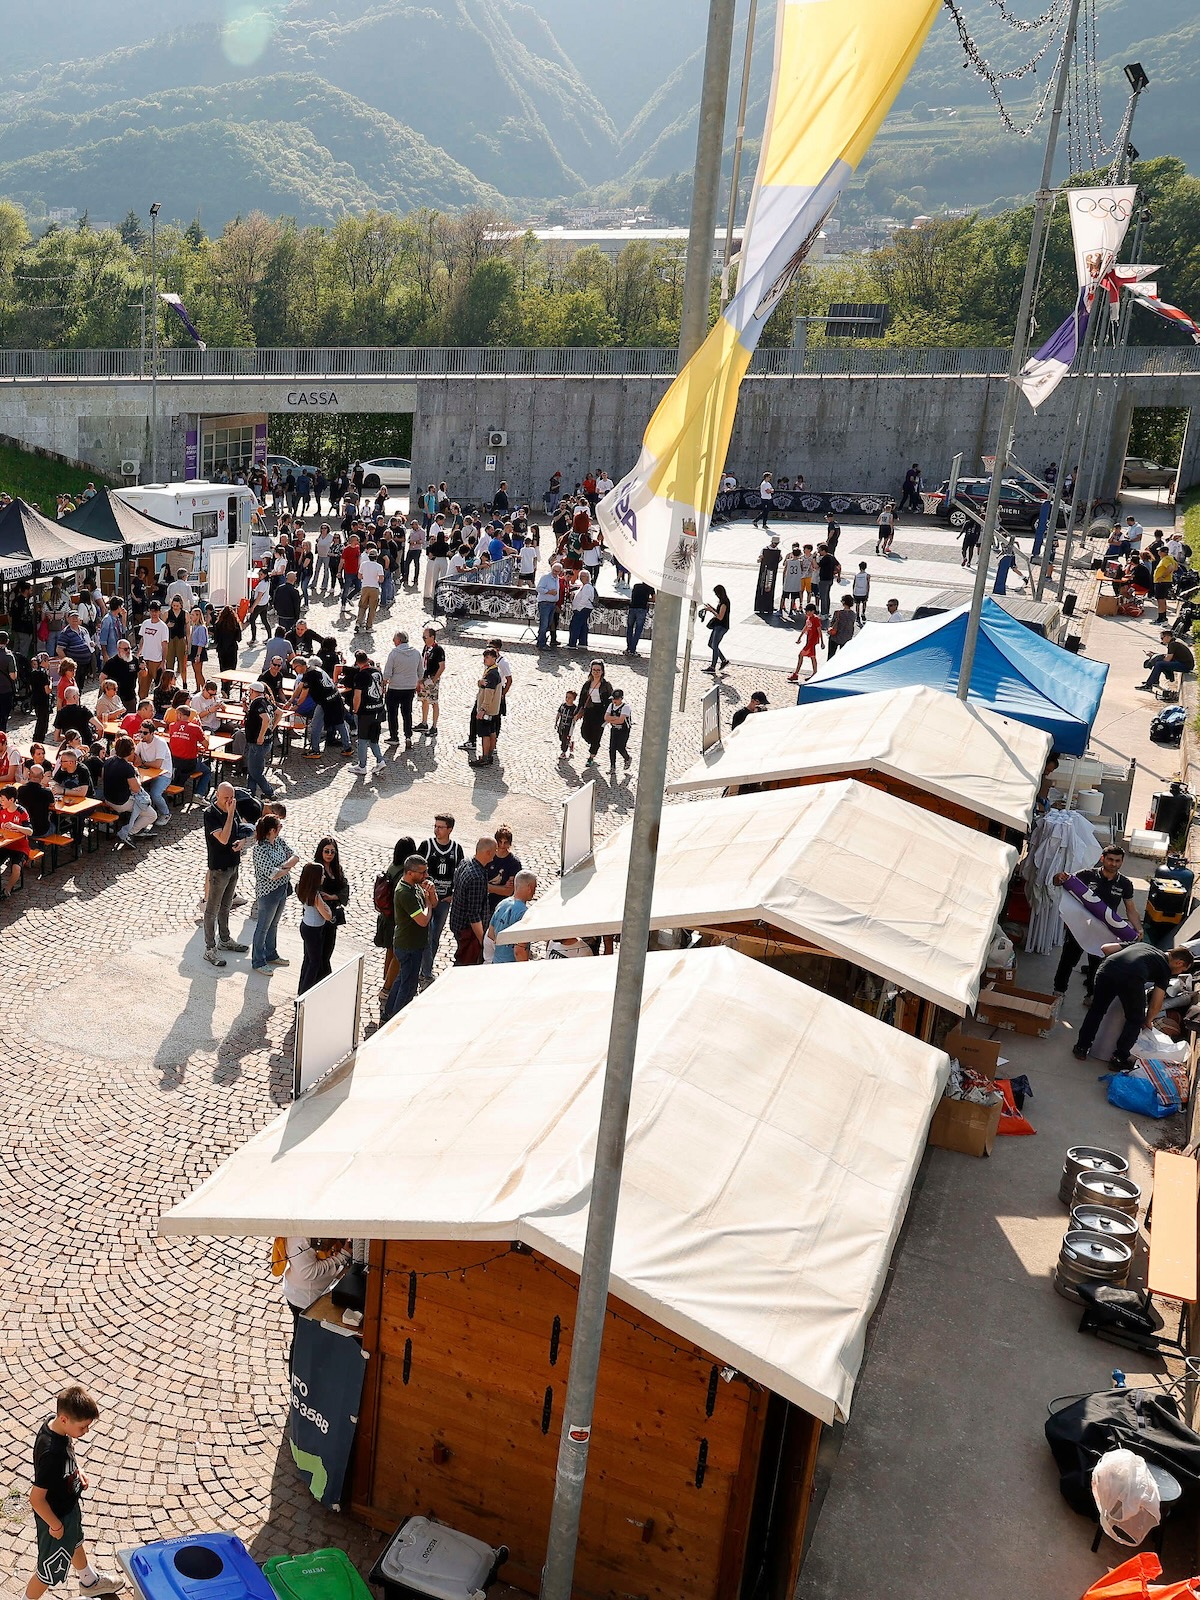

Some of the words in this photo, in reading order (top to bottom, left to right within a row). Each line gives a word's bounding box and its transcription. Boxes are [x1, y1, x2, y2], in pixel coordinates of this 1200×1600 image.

[287, 392, 339, 405] CASSA
[40, 558, 68, 573] AQUILA
[69, 552, 95, 568] BASKET
[3, 562, 33, 579] TRENTO
[789, 565, 798, 575] 33
[437, 863, 447, 875] 10
[301, 1567, 326, 1575] VETRO
